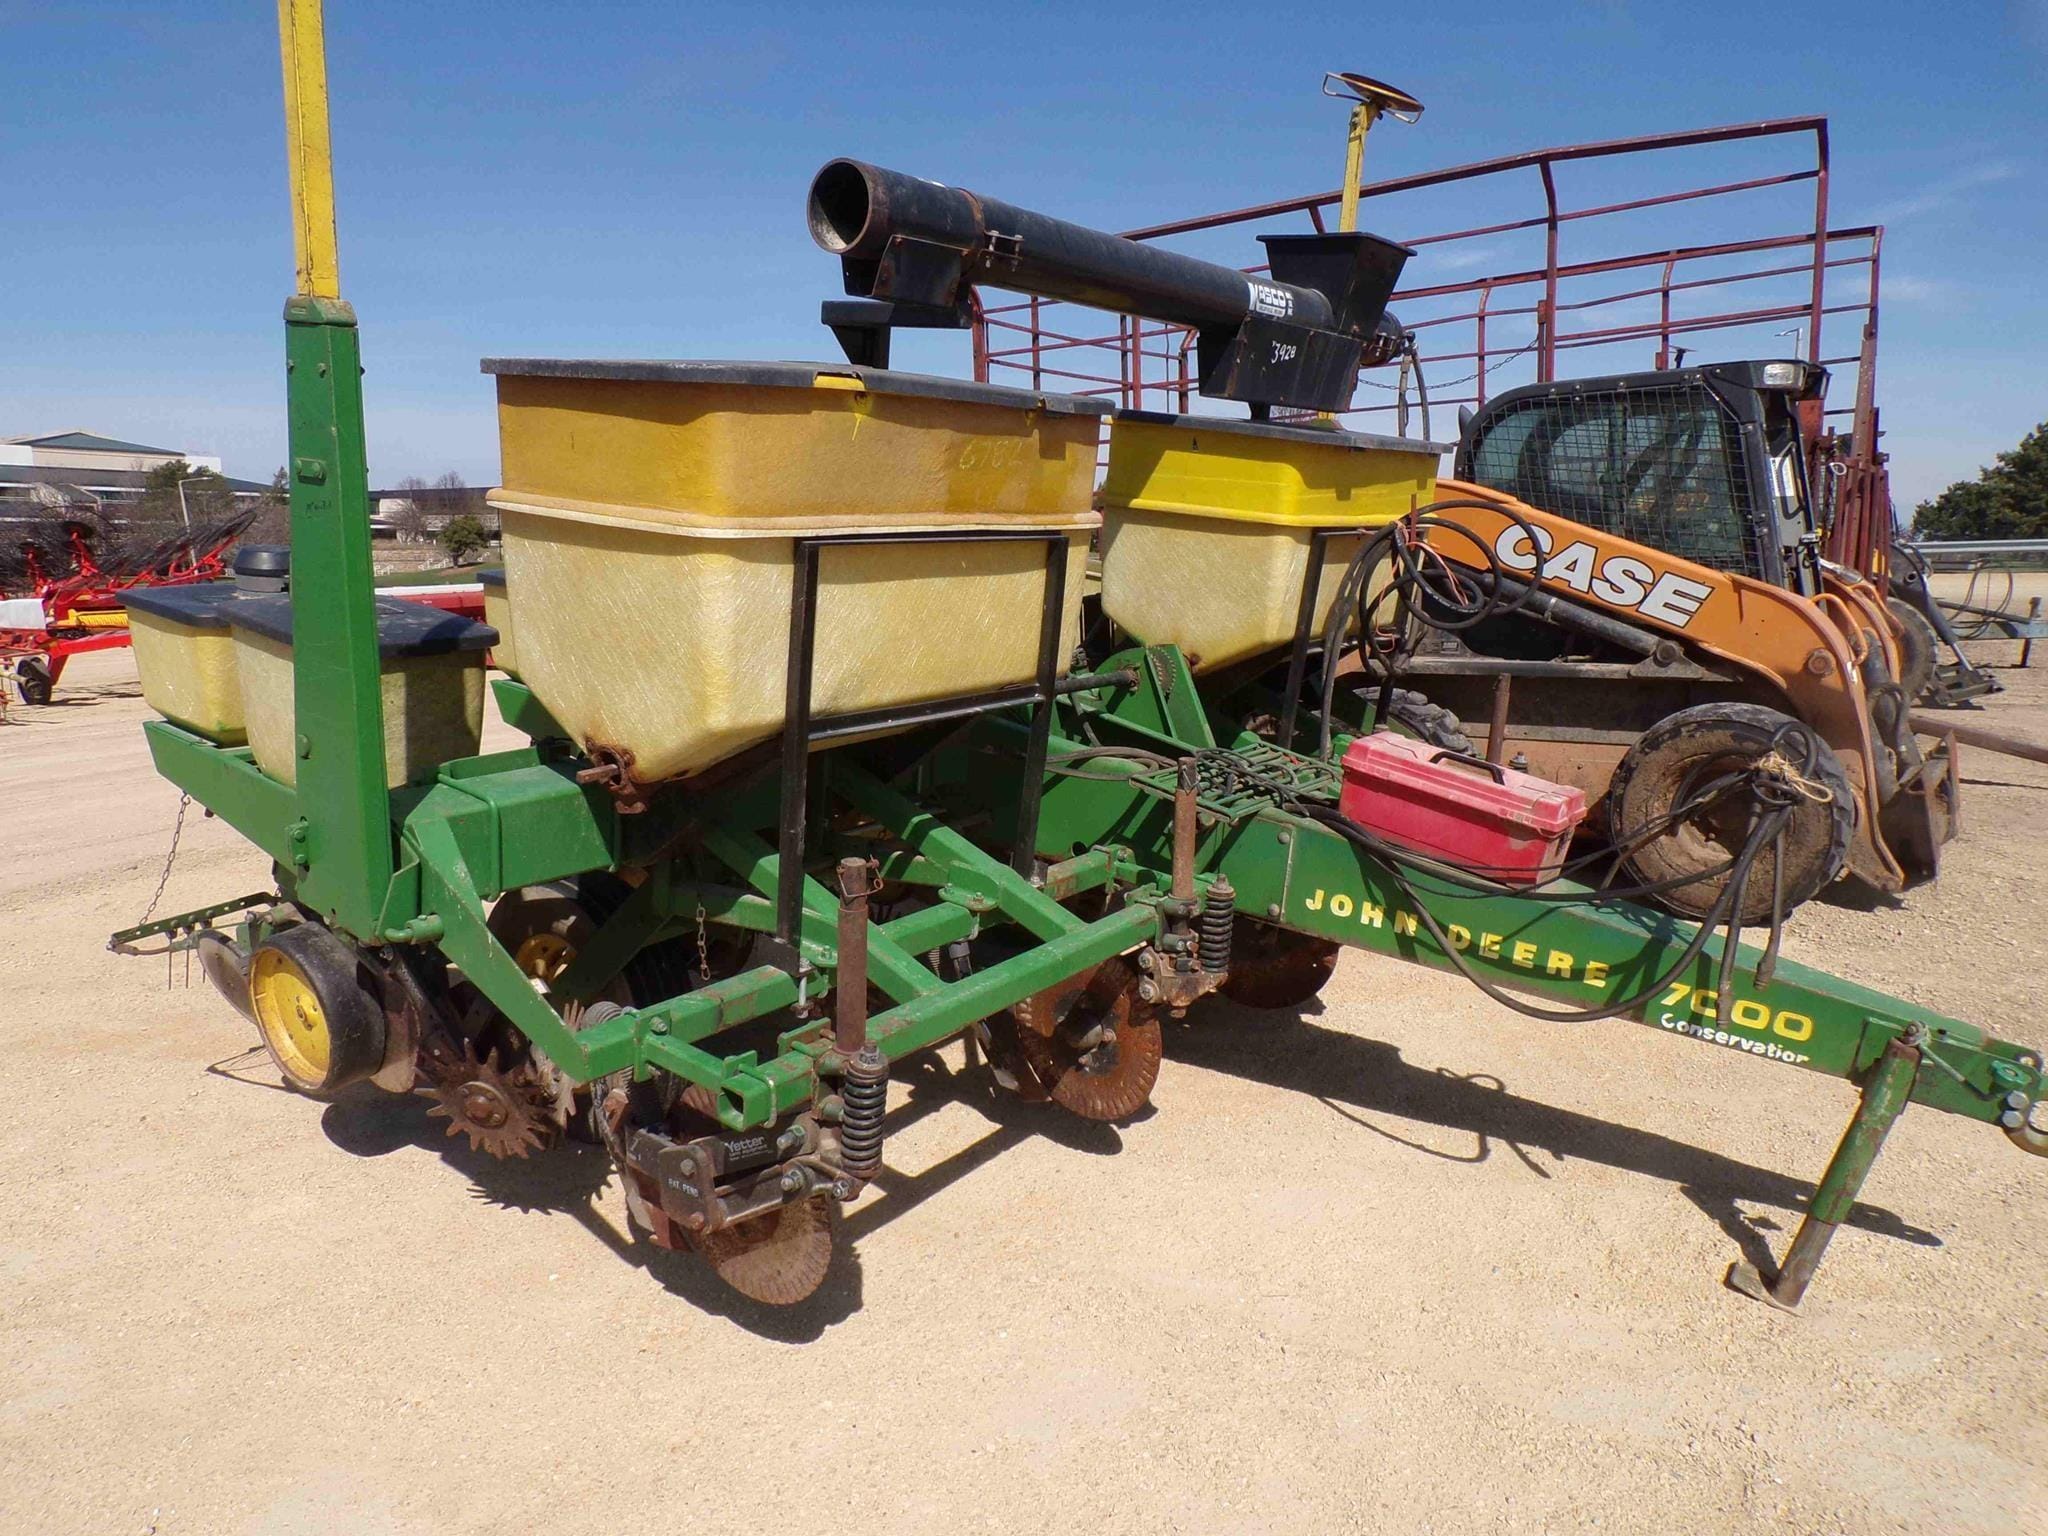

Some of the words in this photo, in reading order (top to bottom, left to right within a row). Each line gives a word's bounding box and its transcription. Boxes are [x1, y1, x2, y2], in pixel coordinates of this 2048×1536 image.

[1495, 522, 1714, 628] CASE
[1305, 888, 1418, 937] JOHN
[1447, 923, 1610, 988] DEERE
[724, 1136, 765, 1153] Yetter
